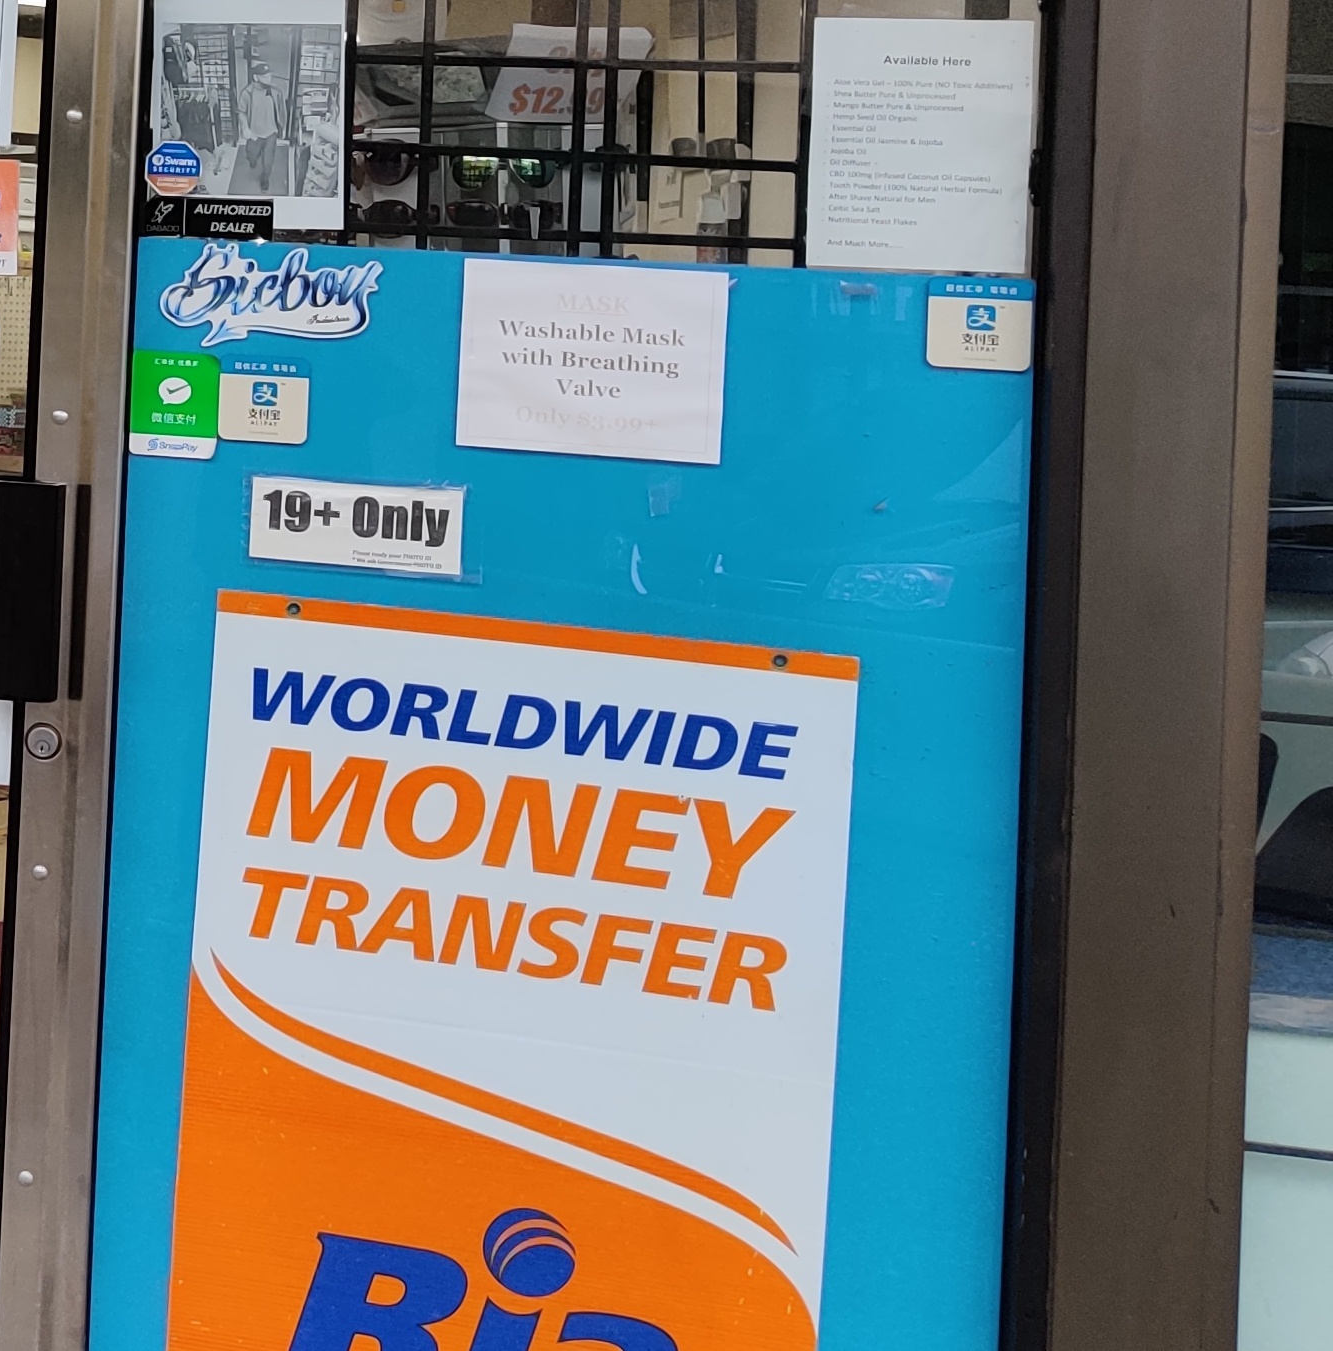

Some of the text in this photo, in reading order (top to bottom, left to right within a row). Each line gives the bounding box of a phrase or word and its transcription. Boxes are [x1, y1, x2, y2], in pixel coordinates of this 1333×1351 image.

[883, 55, 971, 66] Available Here
[194, 203, 272, 216] AUTHORIZED
[146, 224, 180, 232] DABADO
[210, 221, 255, 233] DEALER
[557, 294, 628, 314] MASK
[498, 319, 685, 347] Washable Mask
[961, 333, 1000, 346] 支付宝
[502, 348, 679, 379] with Breathing
[556, 378, 621, 399] Valve
[151, 412, 197, 426] 微信支付
[248, 408, 281, 421] 支付宝
[516, 405, 571, 429] Only
[263, 489, 450, 547] 19+ Only
[251, 667, 799, 781] WORLDWIDE
[245, 747, 798, 899] MONEY
[241, 867, 788, 1013] TRANSFER
